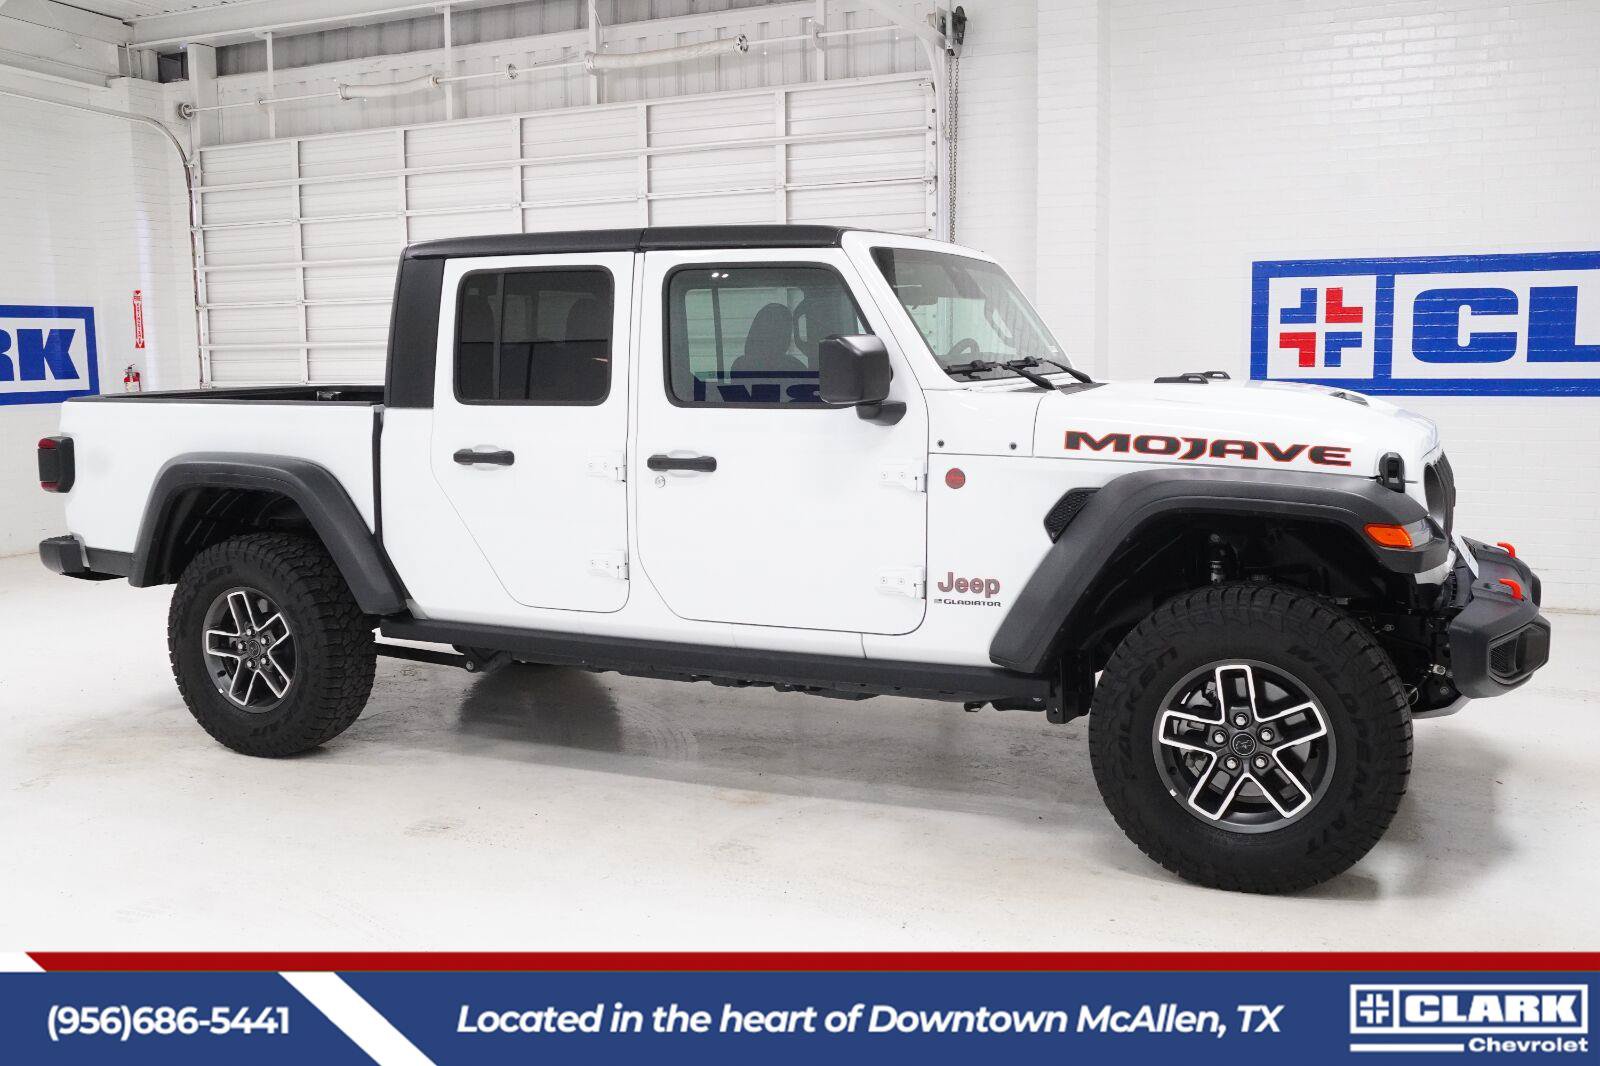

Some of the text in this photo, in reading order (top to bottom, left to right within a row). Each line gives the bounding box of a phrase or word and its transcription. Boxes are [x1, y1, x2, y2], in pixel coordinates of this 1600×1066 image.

[1063, 431, 1352, 467] MOJAVE
[937, 571, 1000, 598] Jeep
[943, 599, 1001, 607] GLADIATOR
